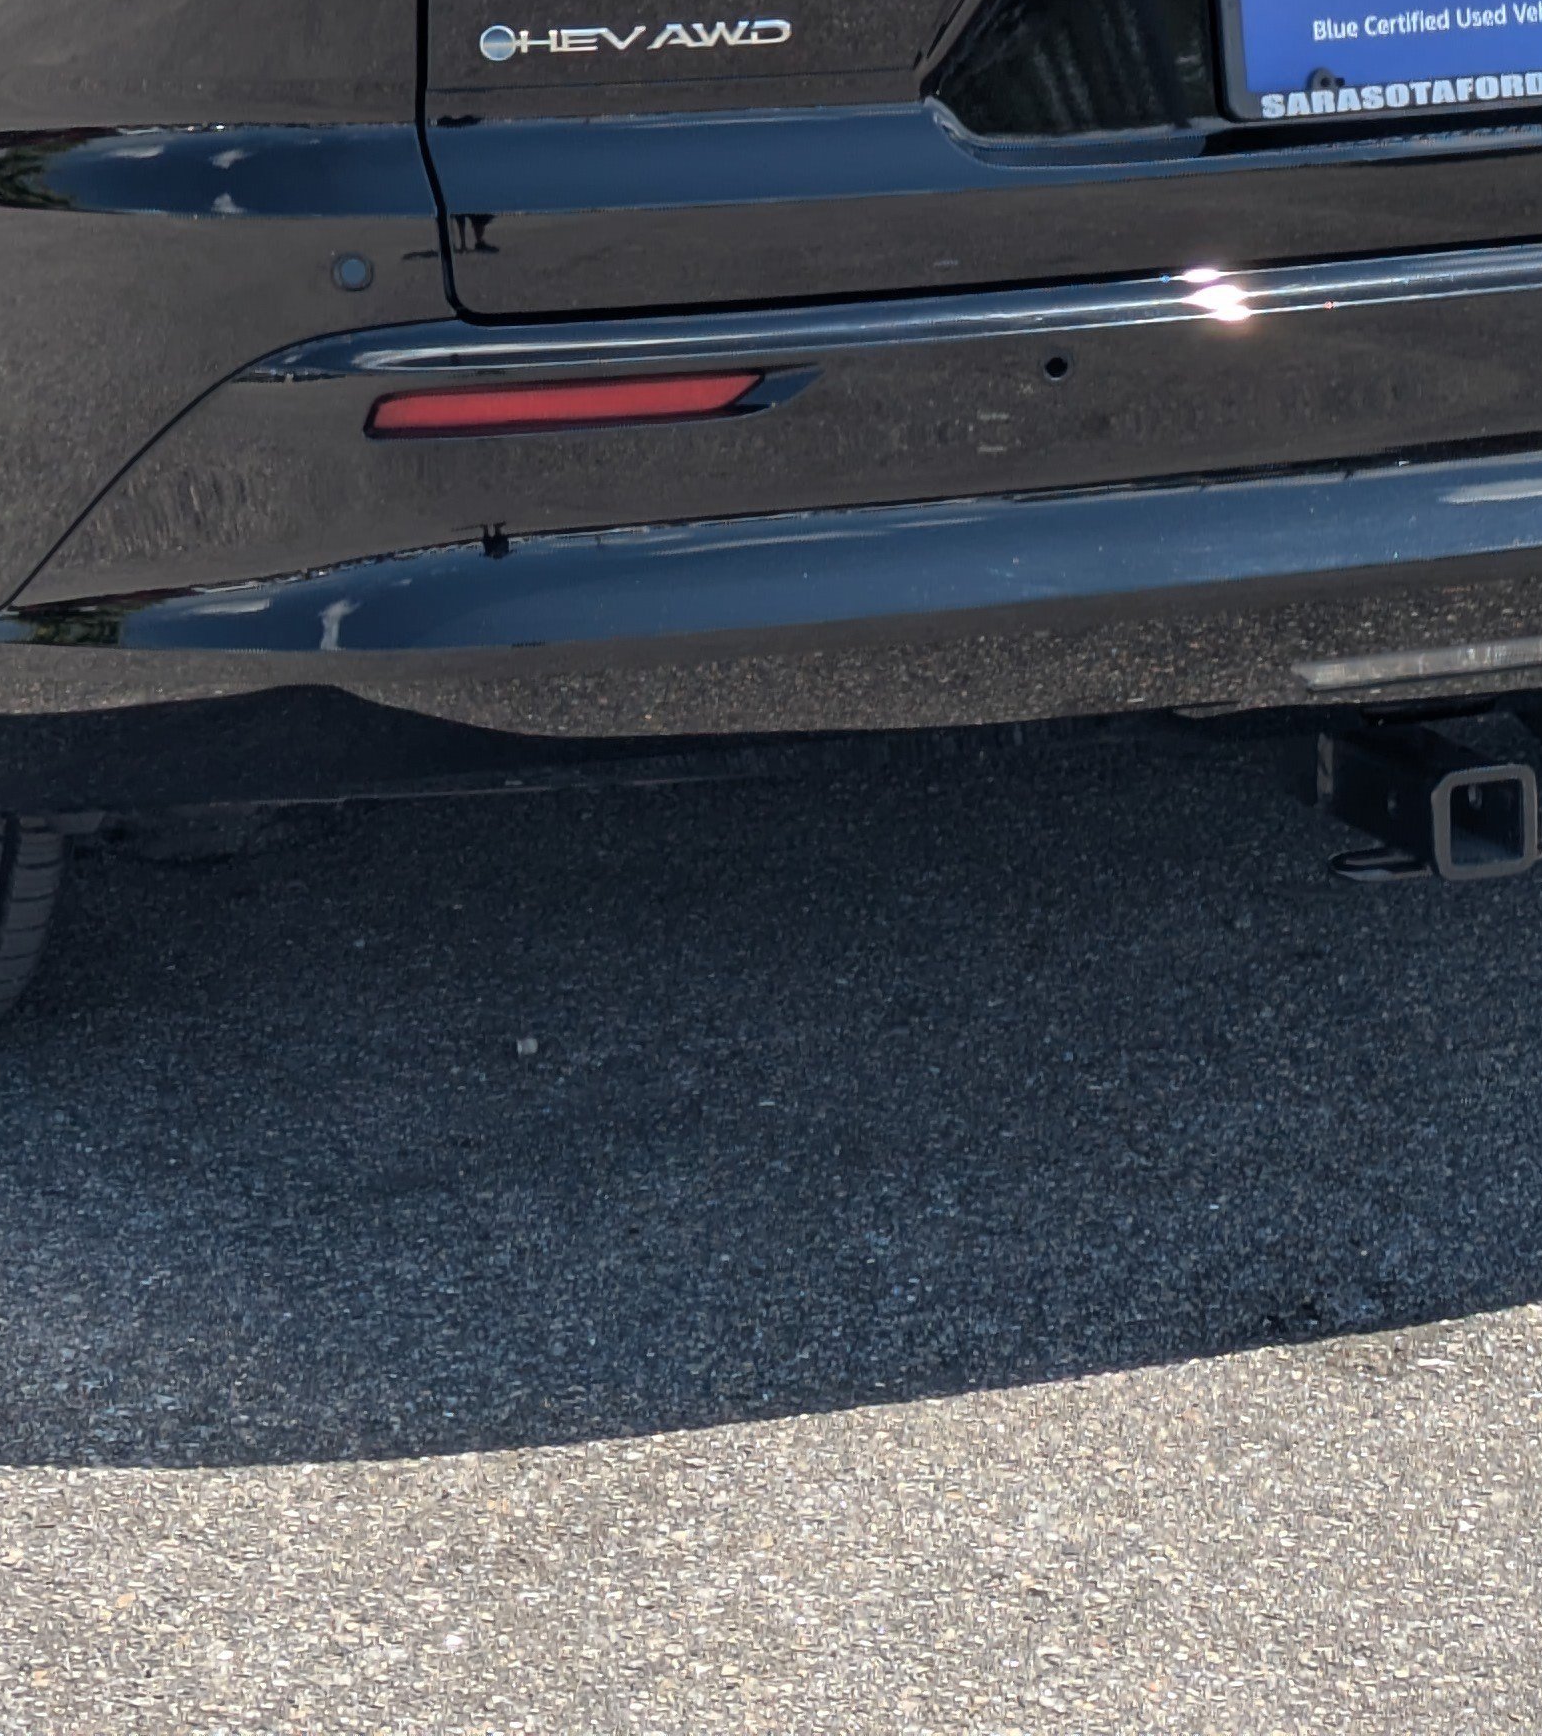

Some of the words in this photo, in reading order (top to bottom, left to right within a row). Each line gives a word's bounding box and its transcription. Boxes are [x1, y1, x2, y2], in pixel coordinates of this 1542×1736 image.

[519, 25, 647, 54] HEV
[646, 18, 792, 51] AWD
[1312, 17, 1359, 41] Blue
[1363, 8, 1450, 37] Certified
[1456, 3, 1507, 28] Used
